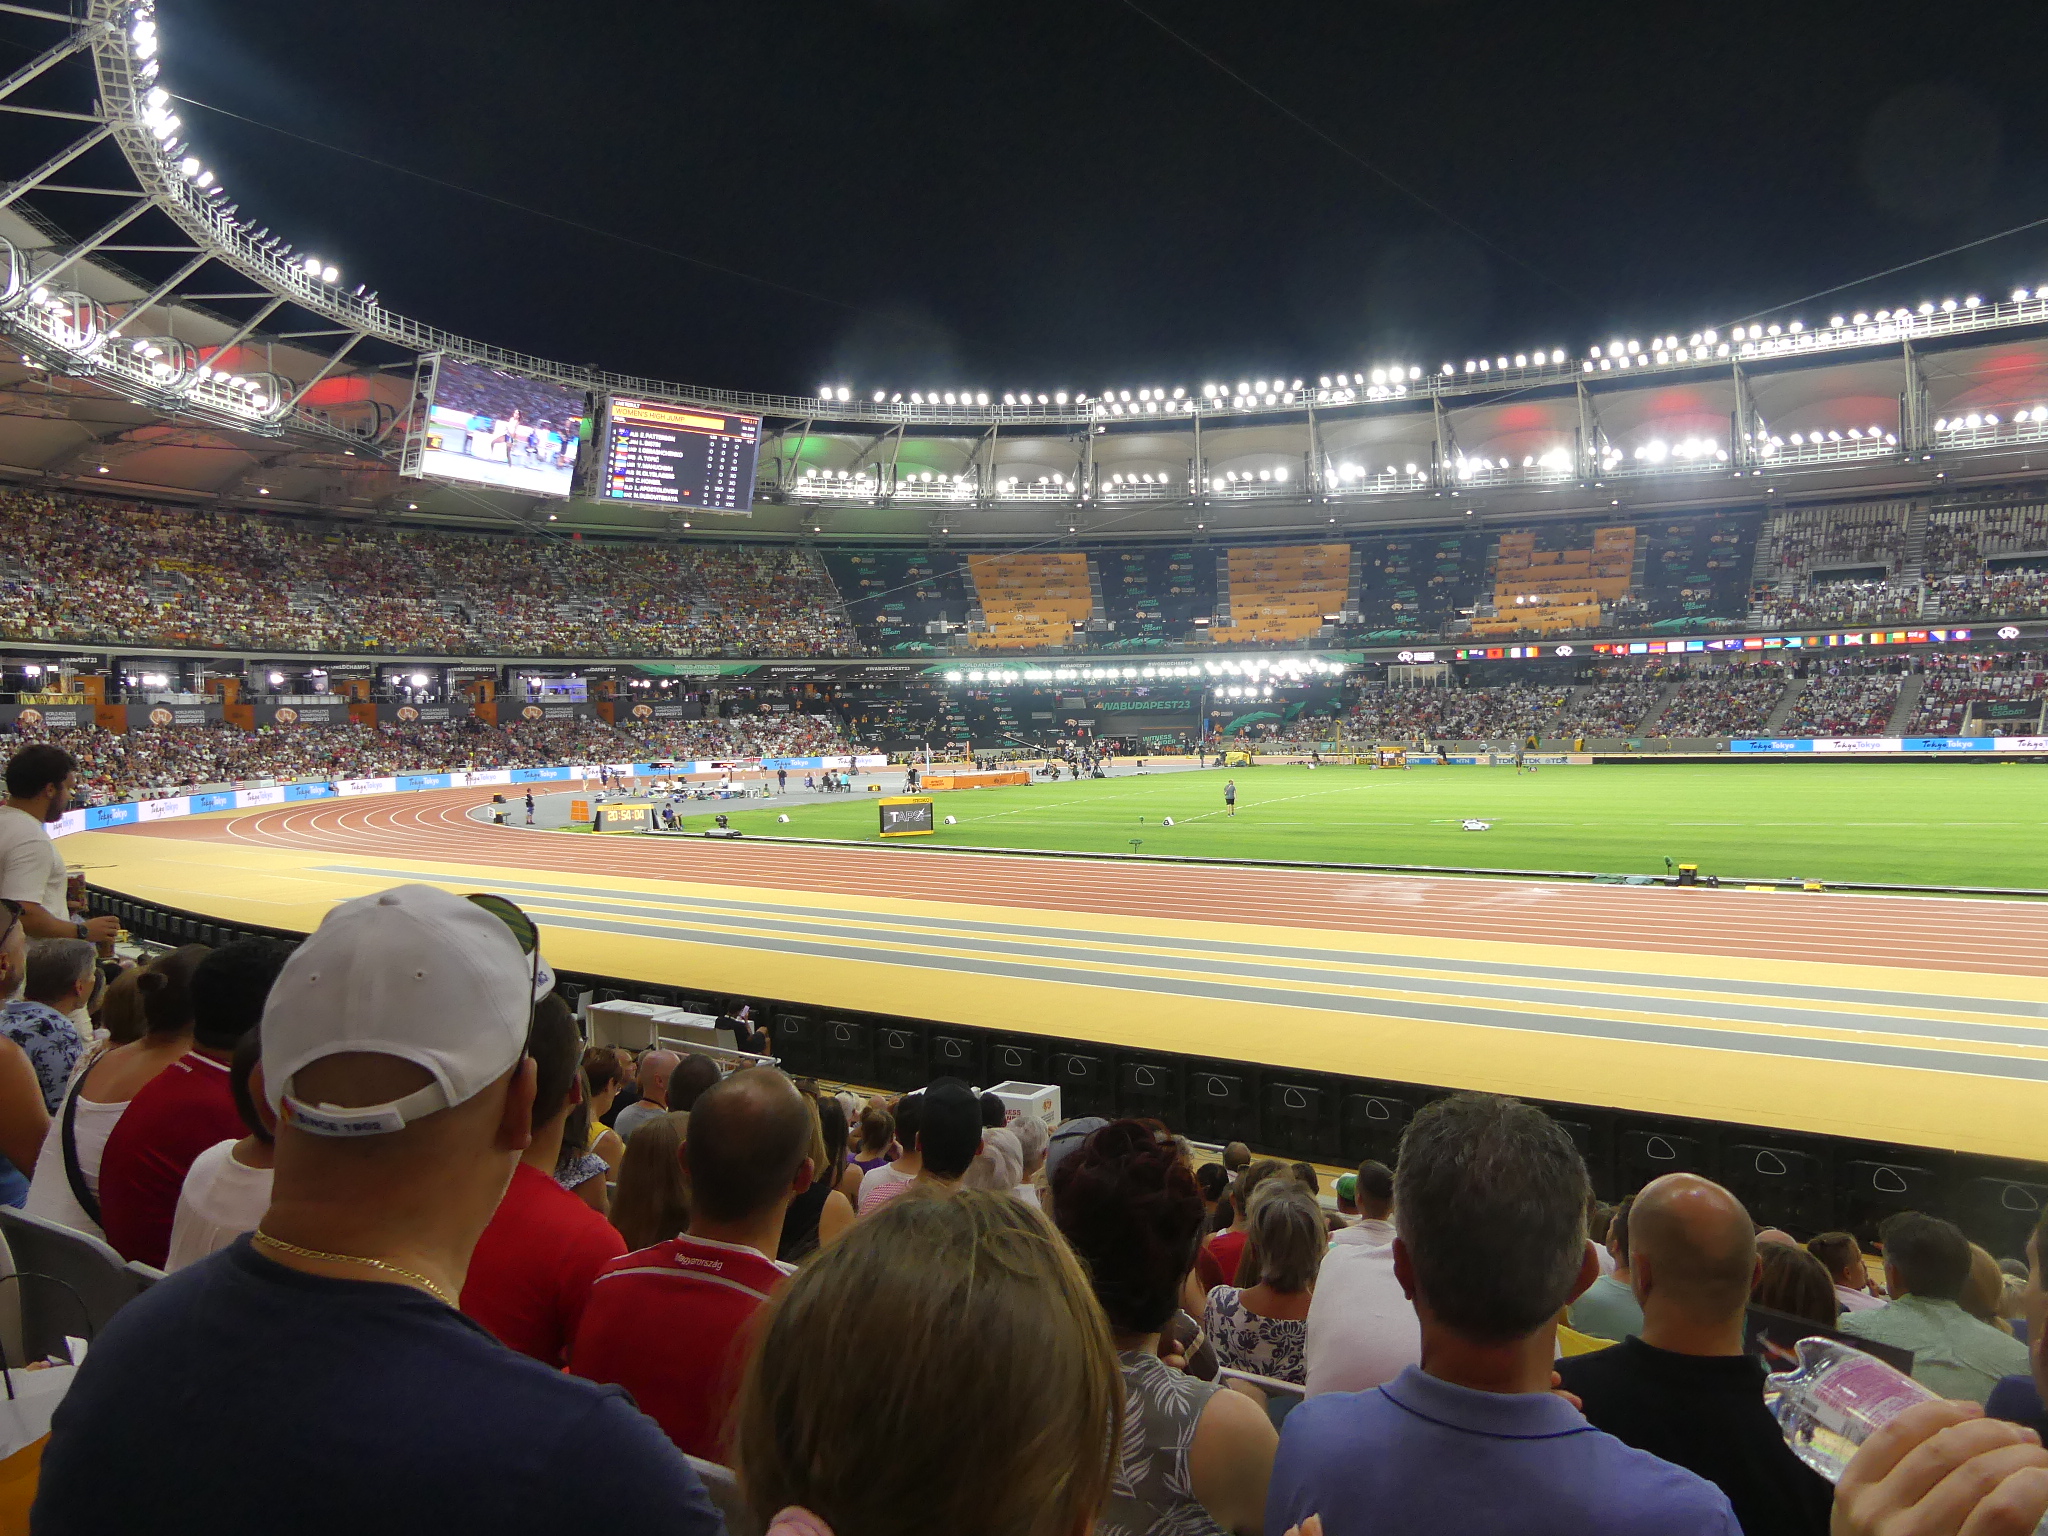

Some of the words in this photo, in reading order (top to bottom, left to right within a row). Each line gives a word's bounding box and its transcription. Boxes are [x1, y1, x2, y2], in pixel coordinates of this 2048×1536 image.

[616, 408, 648, 417] WOMEN'S
[1098, 700, 1191, 711] WABUDAPEST23
[1771, 742, 1794, 750] Tokyo
[1857, 741, 1880, 749] Tokyo
[1946, 740, 1973, 749] Tokyo
[791, 759, 808, 767] Tokyo
[540, 769, 558, 779] Tokyo
[423, 776, 439, 787] Tokyo
[608, 810, 644, 821] 20:54:04
[674, 1252, 724, 1271] Magyarország
